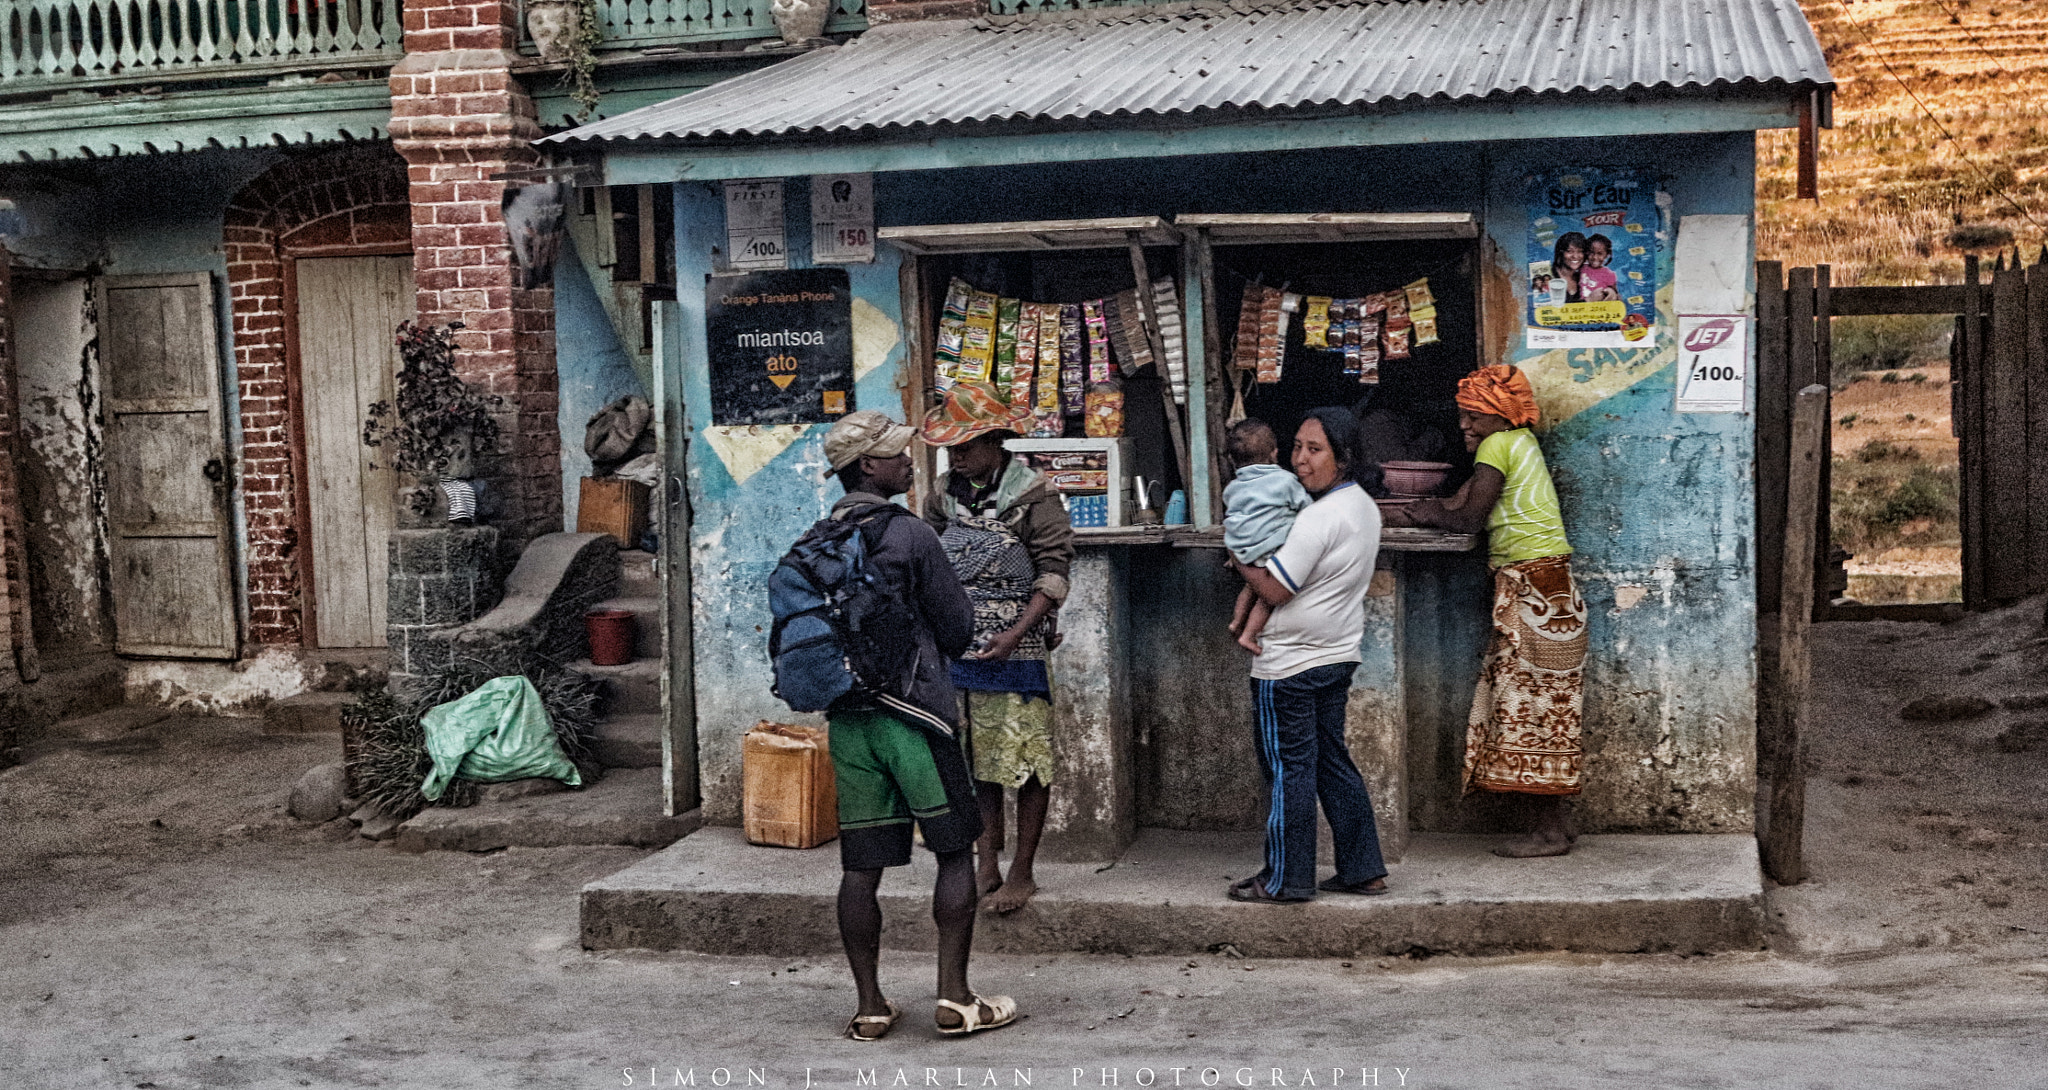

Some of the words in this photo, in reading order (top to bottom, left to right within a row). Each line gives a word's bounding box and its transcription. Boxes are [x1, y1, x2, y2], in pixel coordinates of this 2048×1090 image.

[733, 189, 775, 201] FIRST
[1587, 213, 1620, 225] TOUR
[838, 229, 867, 246] 150
[721, 294, 759, 306] Orange
[801, 291, 835, 302] Phone
[738, 329, 824, 347] miantsoa
[1685, 327, 1729, 346] JET
[766, 354, 798, 371] ato
